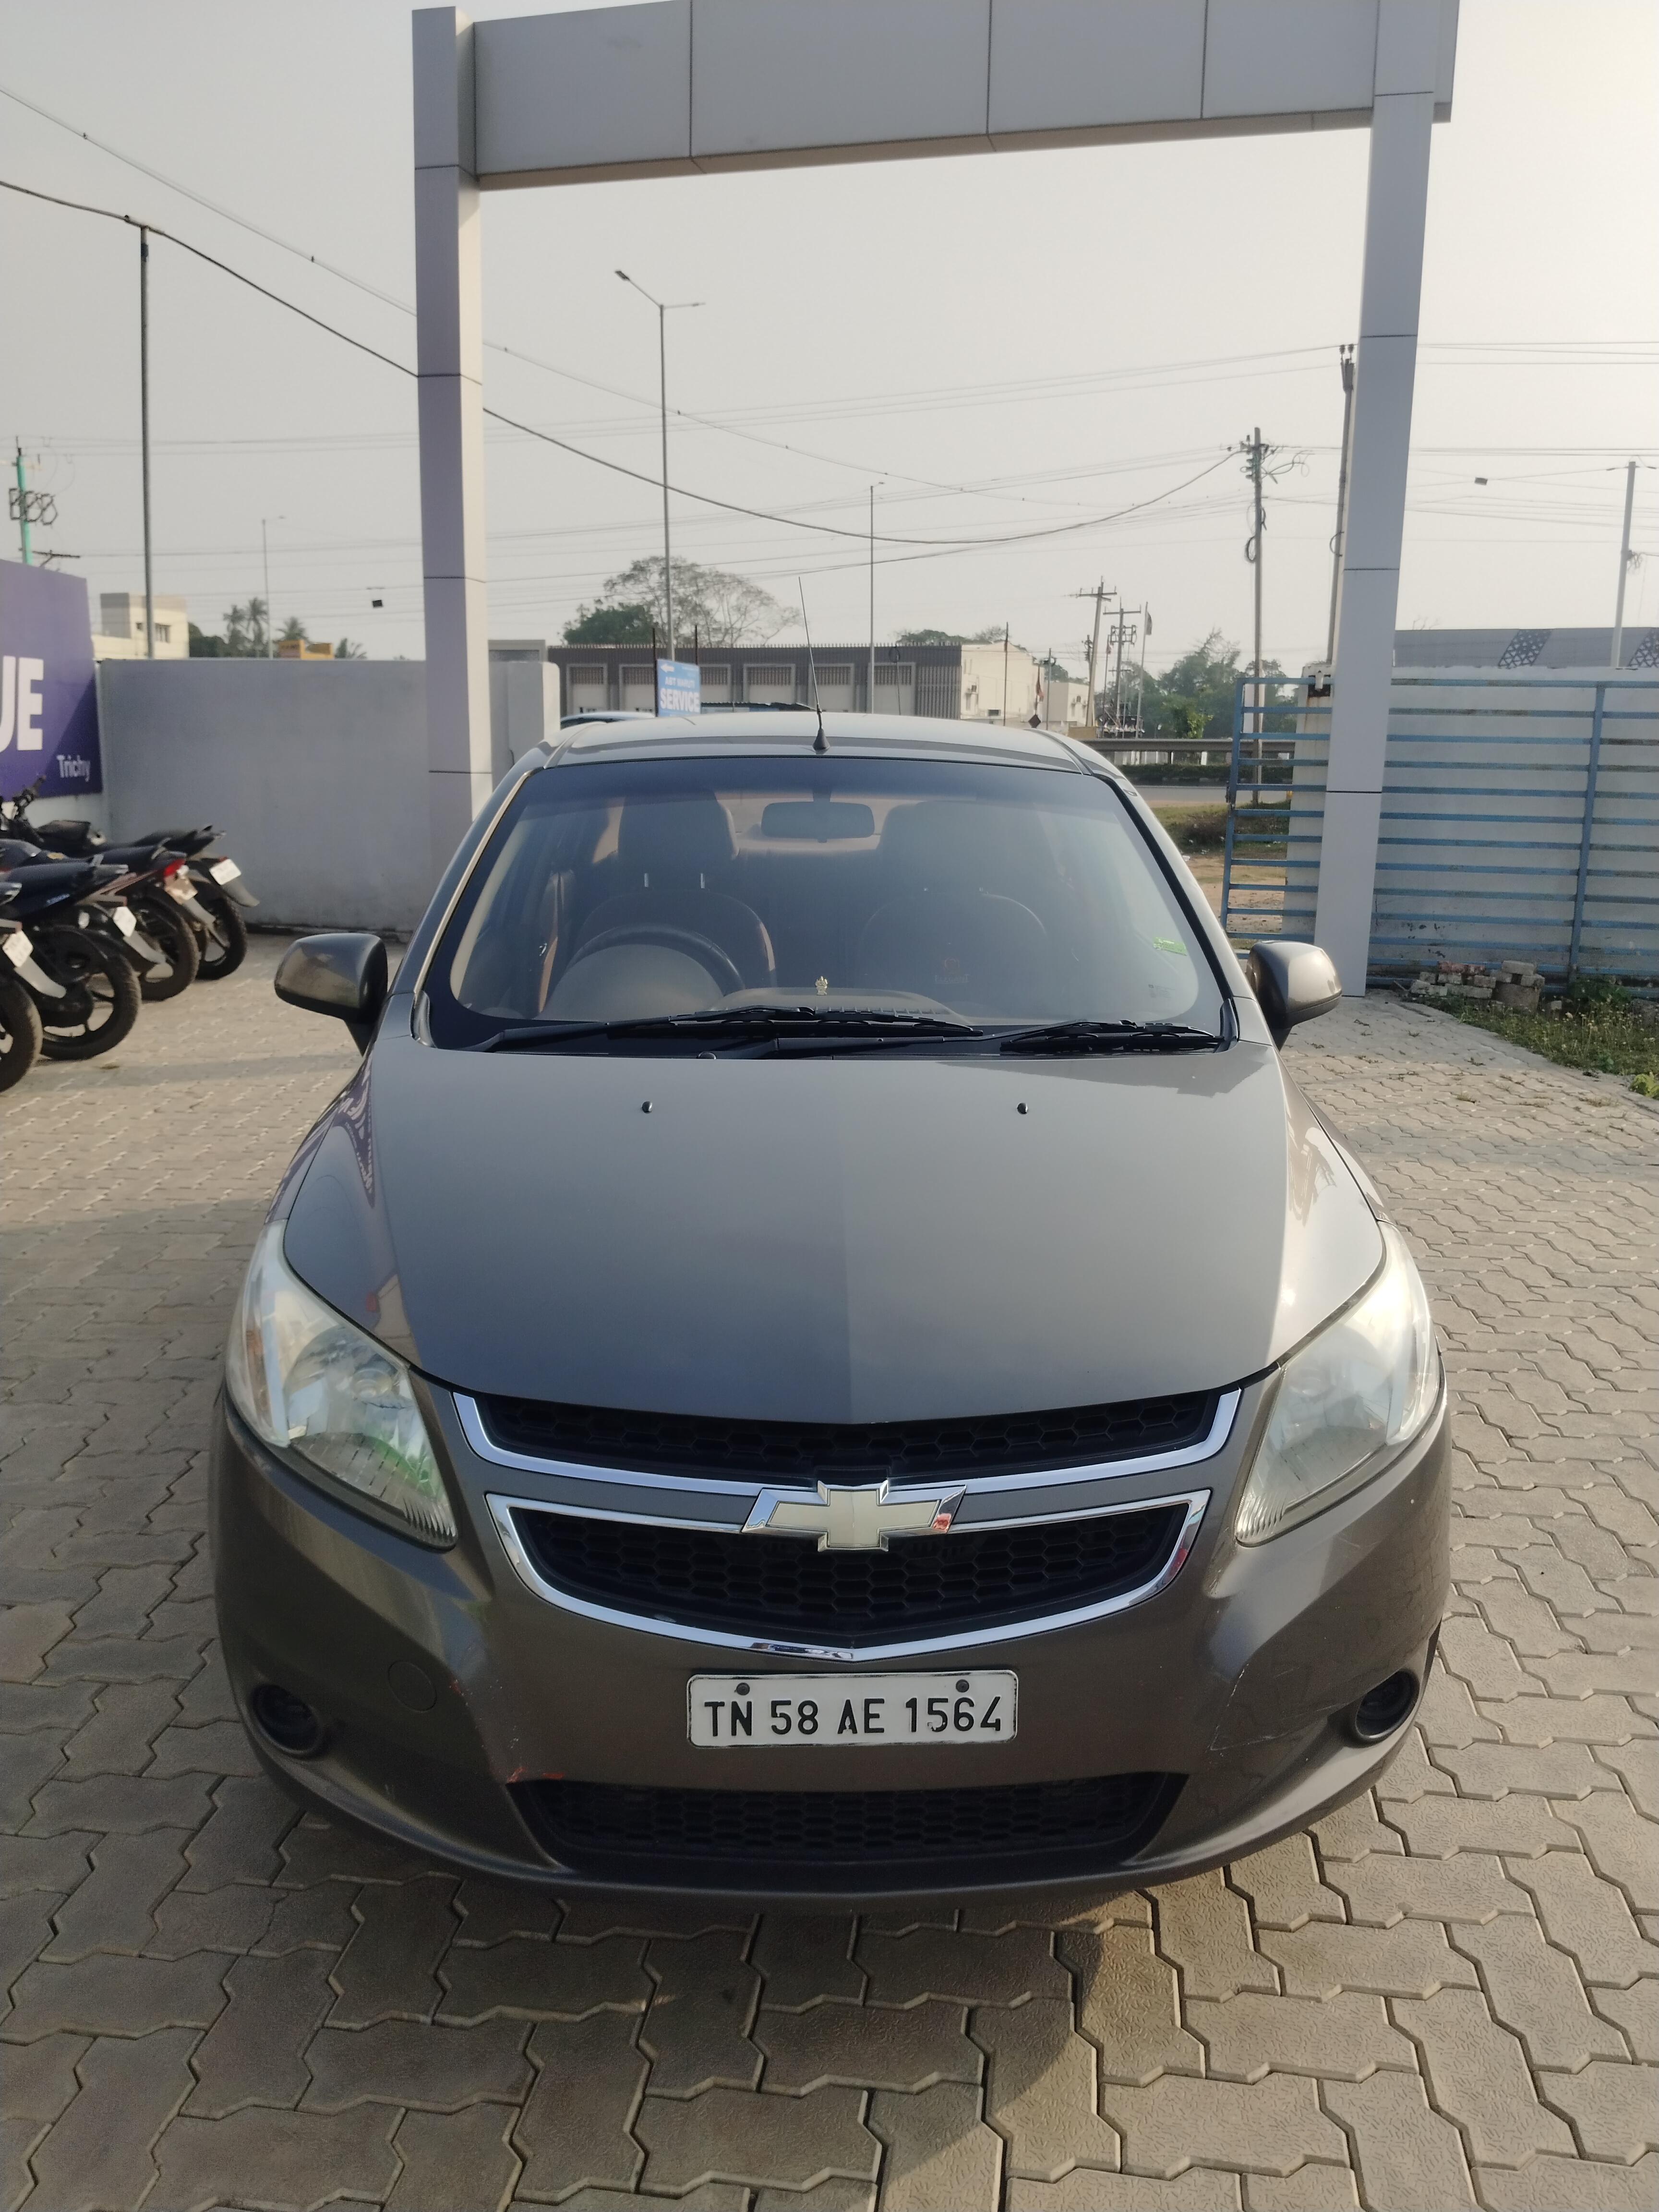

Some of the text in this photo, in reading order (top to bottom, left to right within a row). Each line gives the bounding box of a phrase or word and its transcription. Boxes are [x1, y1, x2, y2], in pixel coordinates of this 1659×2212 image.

[661, 688, 700, 713] SERVICE
[704, 1696, 1001, 1737] TN 58 AE 1564
